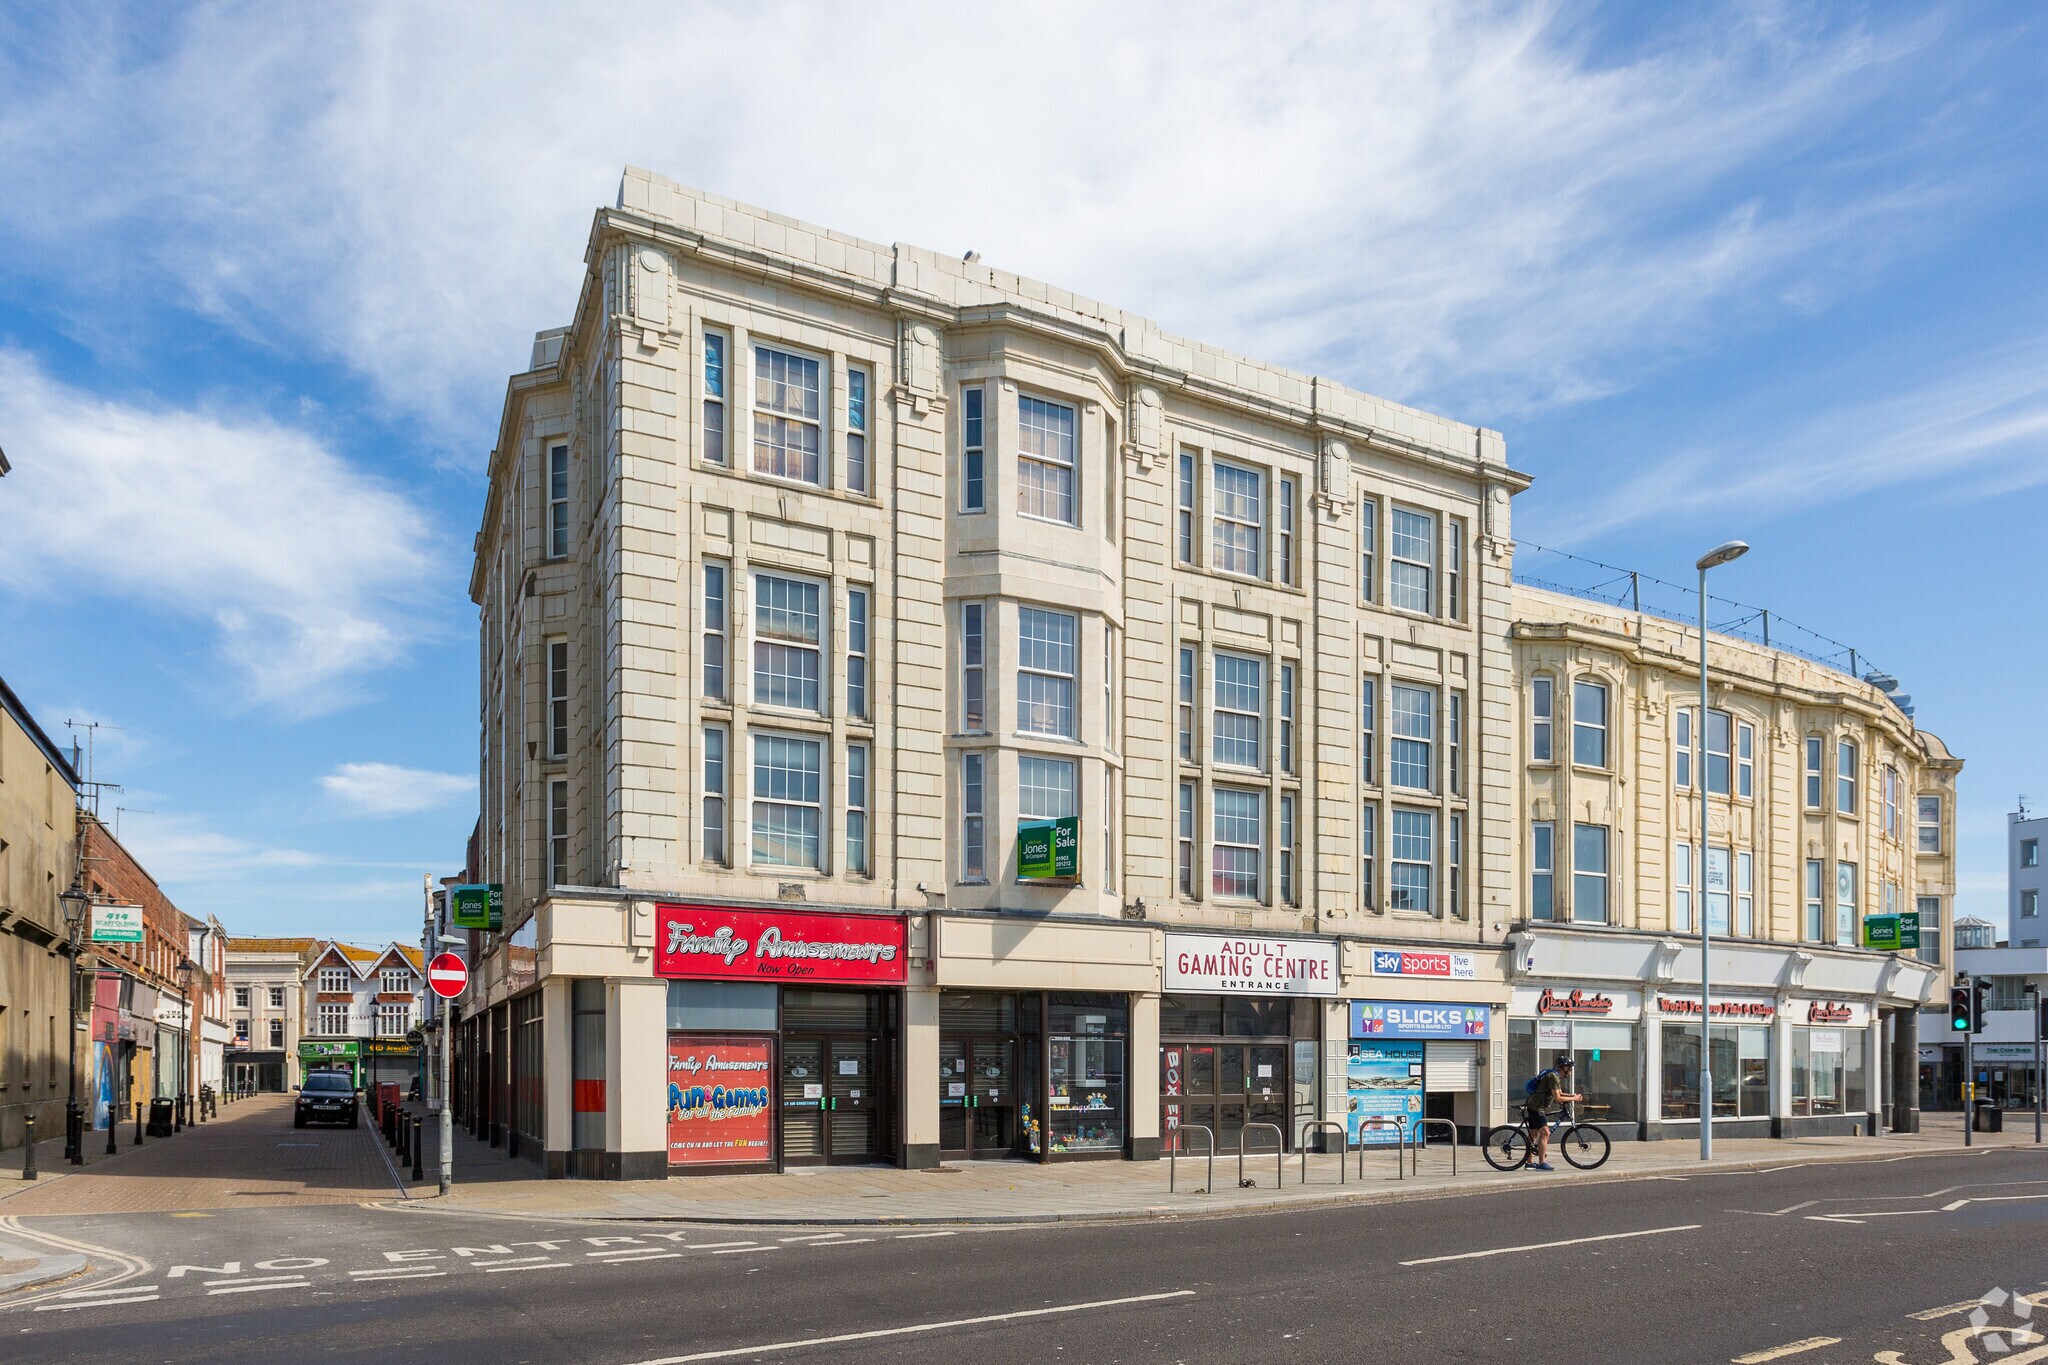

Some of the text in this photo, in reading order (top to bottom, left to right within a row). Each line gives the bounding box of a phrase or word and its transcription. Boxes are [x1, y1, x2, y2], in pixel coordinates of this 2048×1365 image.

[1056, 826, 1072, 836] For
[1022, 844, 1048, 854] Jones
[1056, 836, 1076, 848] Sale
[1020, 864, 1051, 872] Commercial
[460, 901, 482, 909] Jones
[665, 920, 898, 966] Family Amusements
[1221, 941, 1288, 957] ADULT
[1178, 952, 1328, 980] GAMING CENTRE
[1377, 954, 1448, 972] sky sports
[1454, 955, 1469, 966] live
[757, 964, 814, 976] Now Open
[1454, 967, 1474, 977] here
[1221, 980, 1290, 990] ENTRANCE
[1660, 998, 1774, 1016] World Faous Fish & Chips
[1386, 1008, 1462, 1024] SLICKS
[1361, 1050, 1422, 1058] SEA HOUSE
[668, 1054, 769, 1075] Family Amusements
[669, 1082, 704, 1112] Fun
[712, 1085, 769, 1109] Games
[1166, 1051, 1179, 1130] BOXER
[679, 1101, 762, 1120] for all the Family!
[166, 1231, 687, 1278] NO ENTRY
